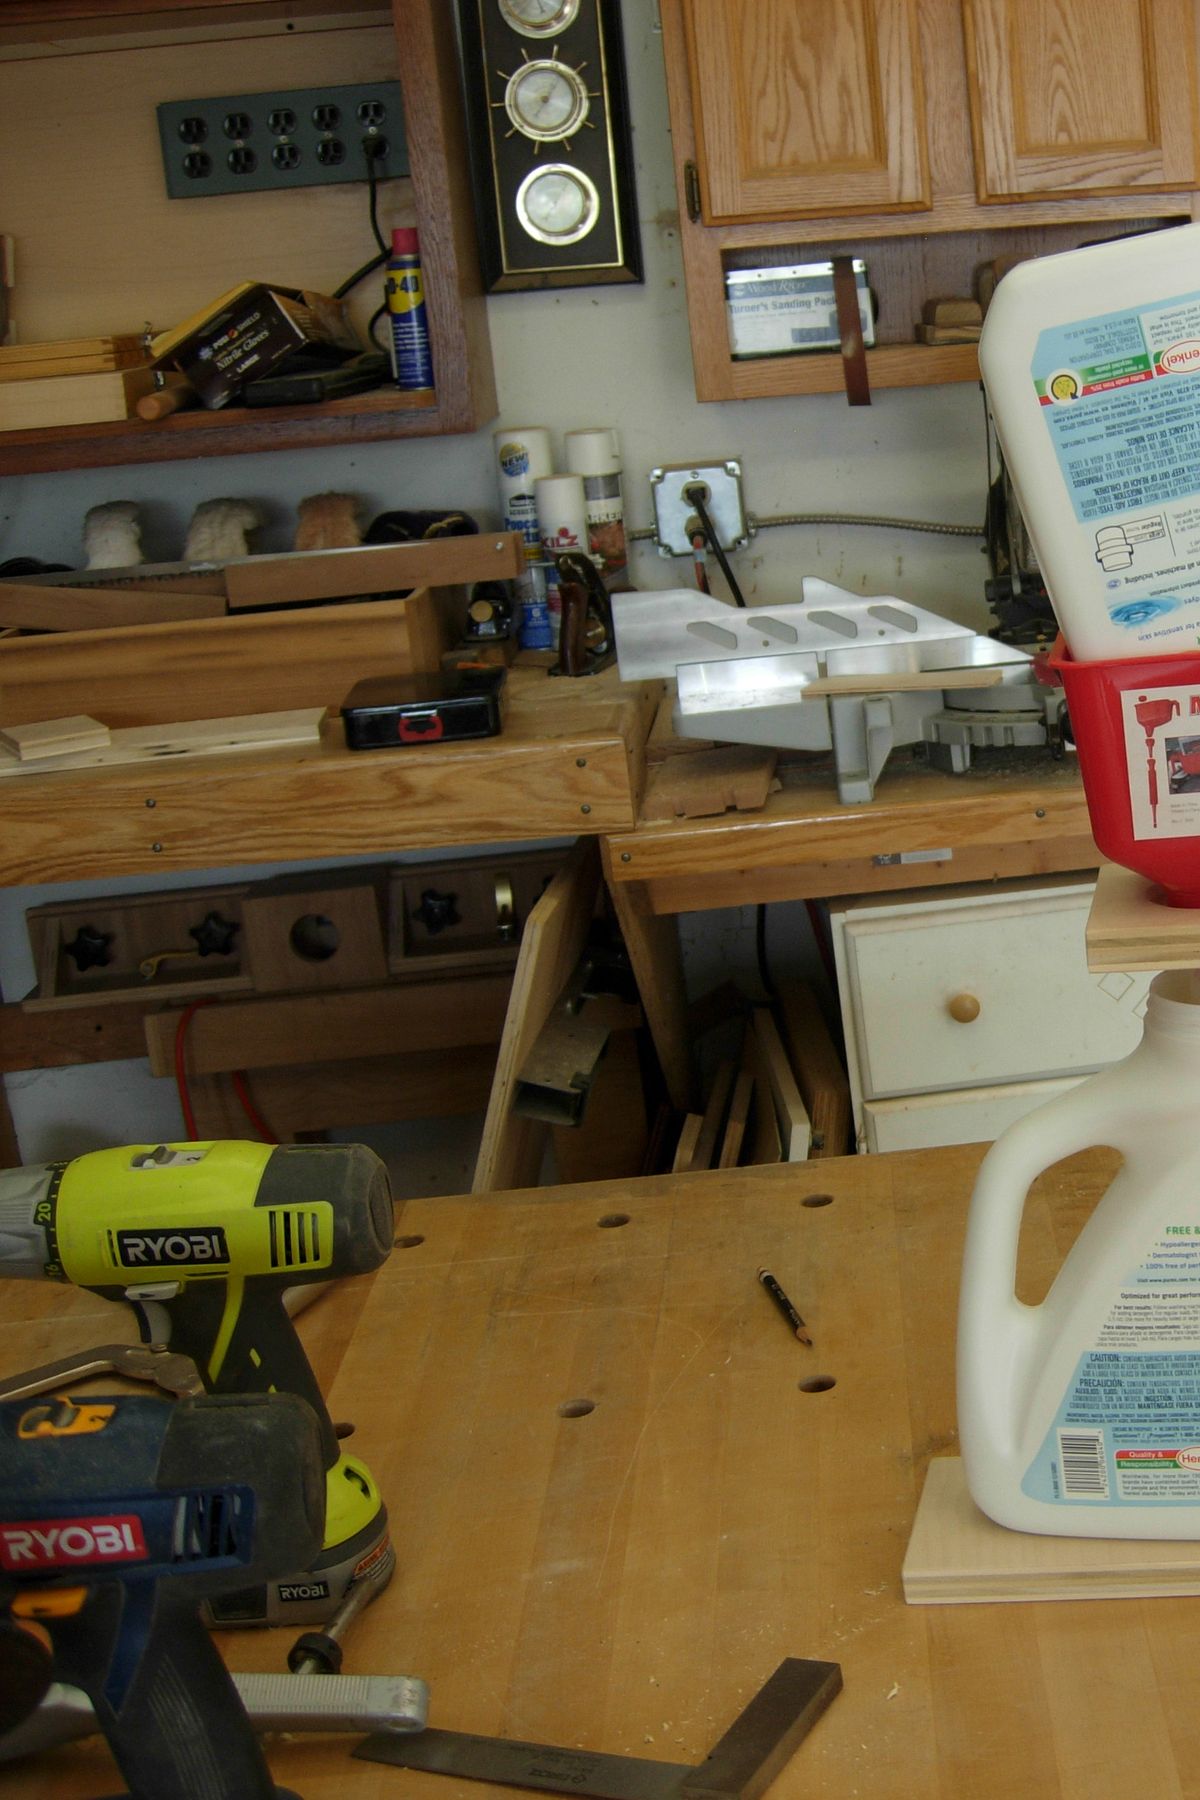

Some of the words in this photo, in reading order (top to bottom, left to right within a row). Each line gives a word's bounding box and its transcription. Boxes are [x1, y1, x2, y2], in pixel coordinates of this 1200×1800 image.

[730, 302, 769, 314] Turner's
[772, 297, 812, 310] Sanding
[216, 348, 243, 371] Nitrile
[243, 330, 270, 351] Gloves
[1159, 470, 1169, 480] OUT
[1171, 466, 1184, 477] KEEP
[1130, 475, 1148, 487] REACH
[542, 535, 579, 548] KILZ
[1125, 571, 1152, 586] including
[1184, 594, 1199, 605] dyes
[1154, 624, 1182, 638] sensitive
[1185, 622, 1194, 630] for
[1138, 632, 1151, 642] skin
[37, 1203, 52, 1222] 20
[1166, 1225, 1190, 1234] FREE
[1194, 1225, 1200, 1233] &
[123, 1235, 222, 1262] RYOBI
[1152, 1251, 1197, 1259] Dermatologist
[1120, 1291, 1149, 1300] Optimized
[1162, 1291, 1177, 1299] great
[1090, 1352, 1121, 1362] CAUTION:
[1129, 1450, 1154, 1459] Quality
[1120, 1458, 1173, 1470] Responsibility
[3, 1523, 136, 1561] RYOBI
[279, 1585, 325, 1600] RYOBI
